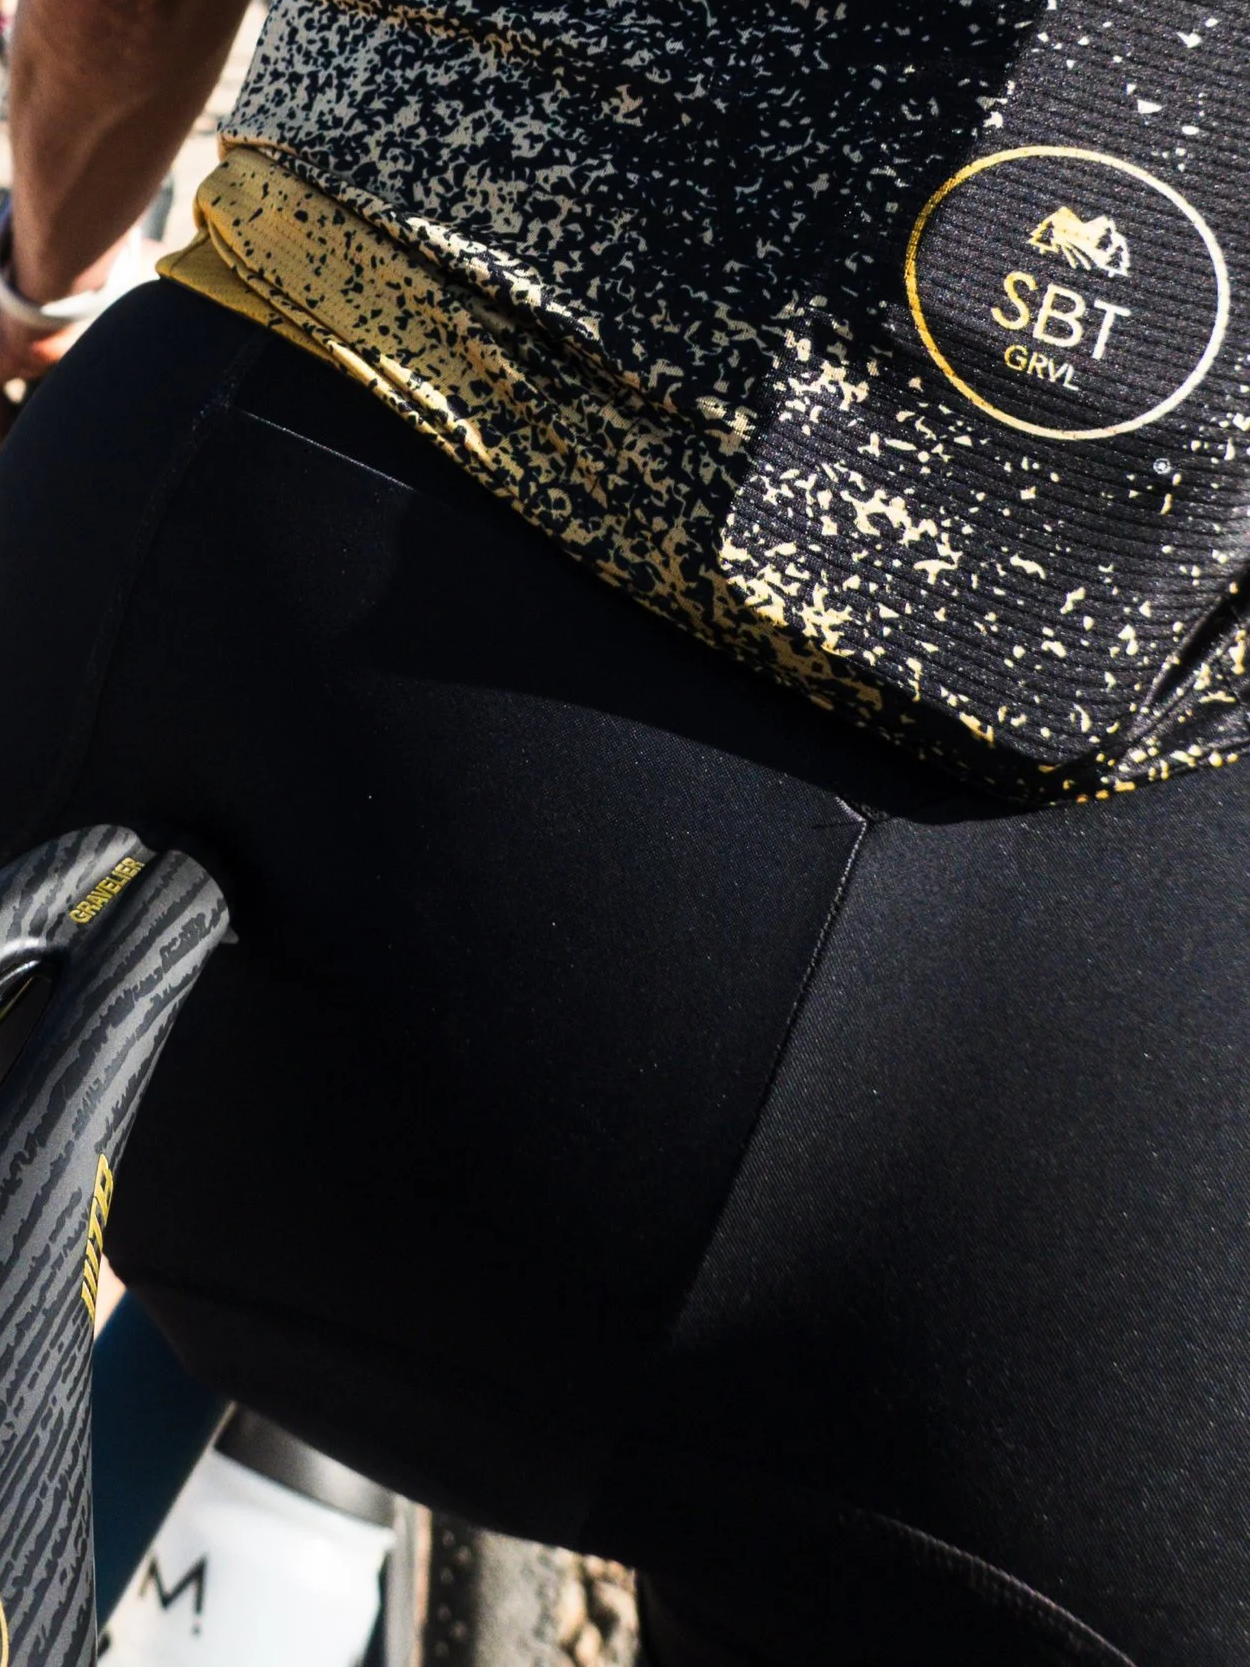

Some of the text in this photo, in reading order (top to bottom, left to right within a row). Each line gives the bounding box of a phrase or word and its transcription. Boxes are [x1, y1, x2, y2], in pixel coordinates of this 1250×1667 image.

[991, 270, 1131, 360] SBT
[1004, 345, 1079, 391] GRVL
[69, 856, 146, 924] GRAVELIER
